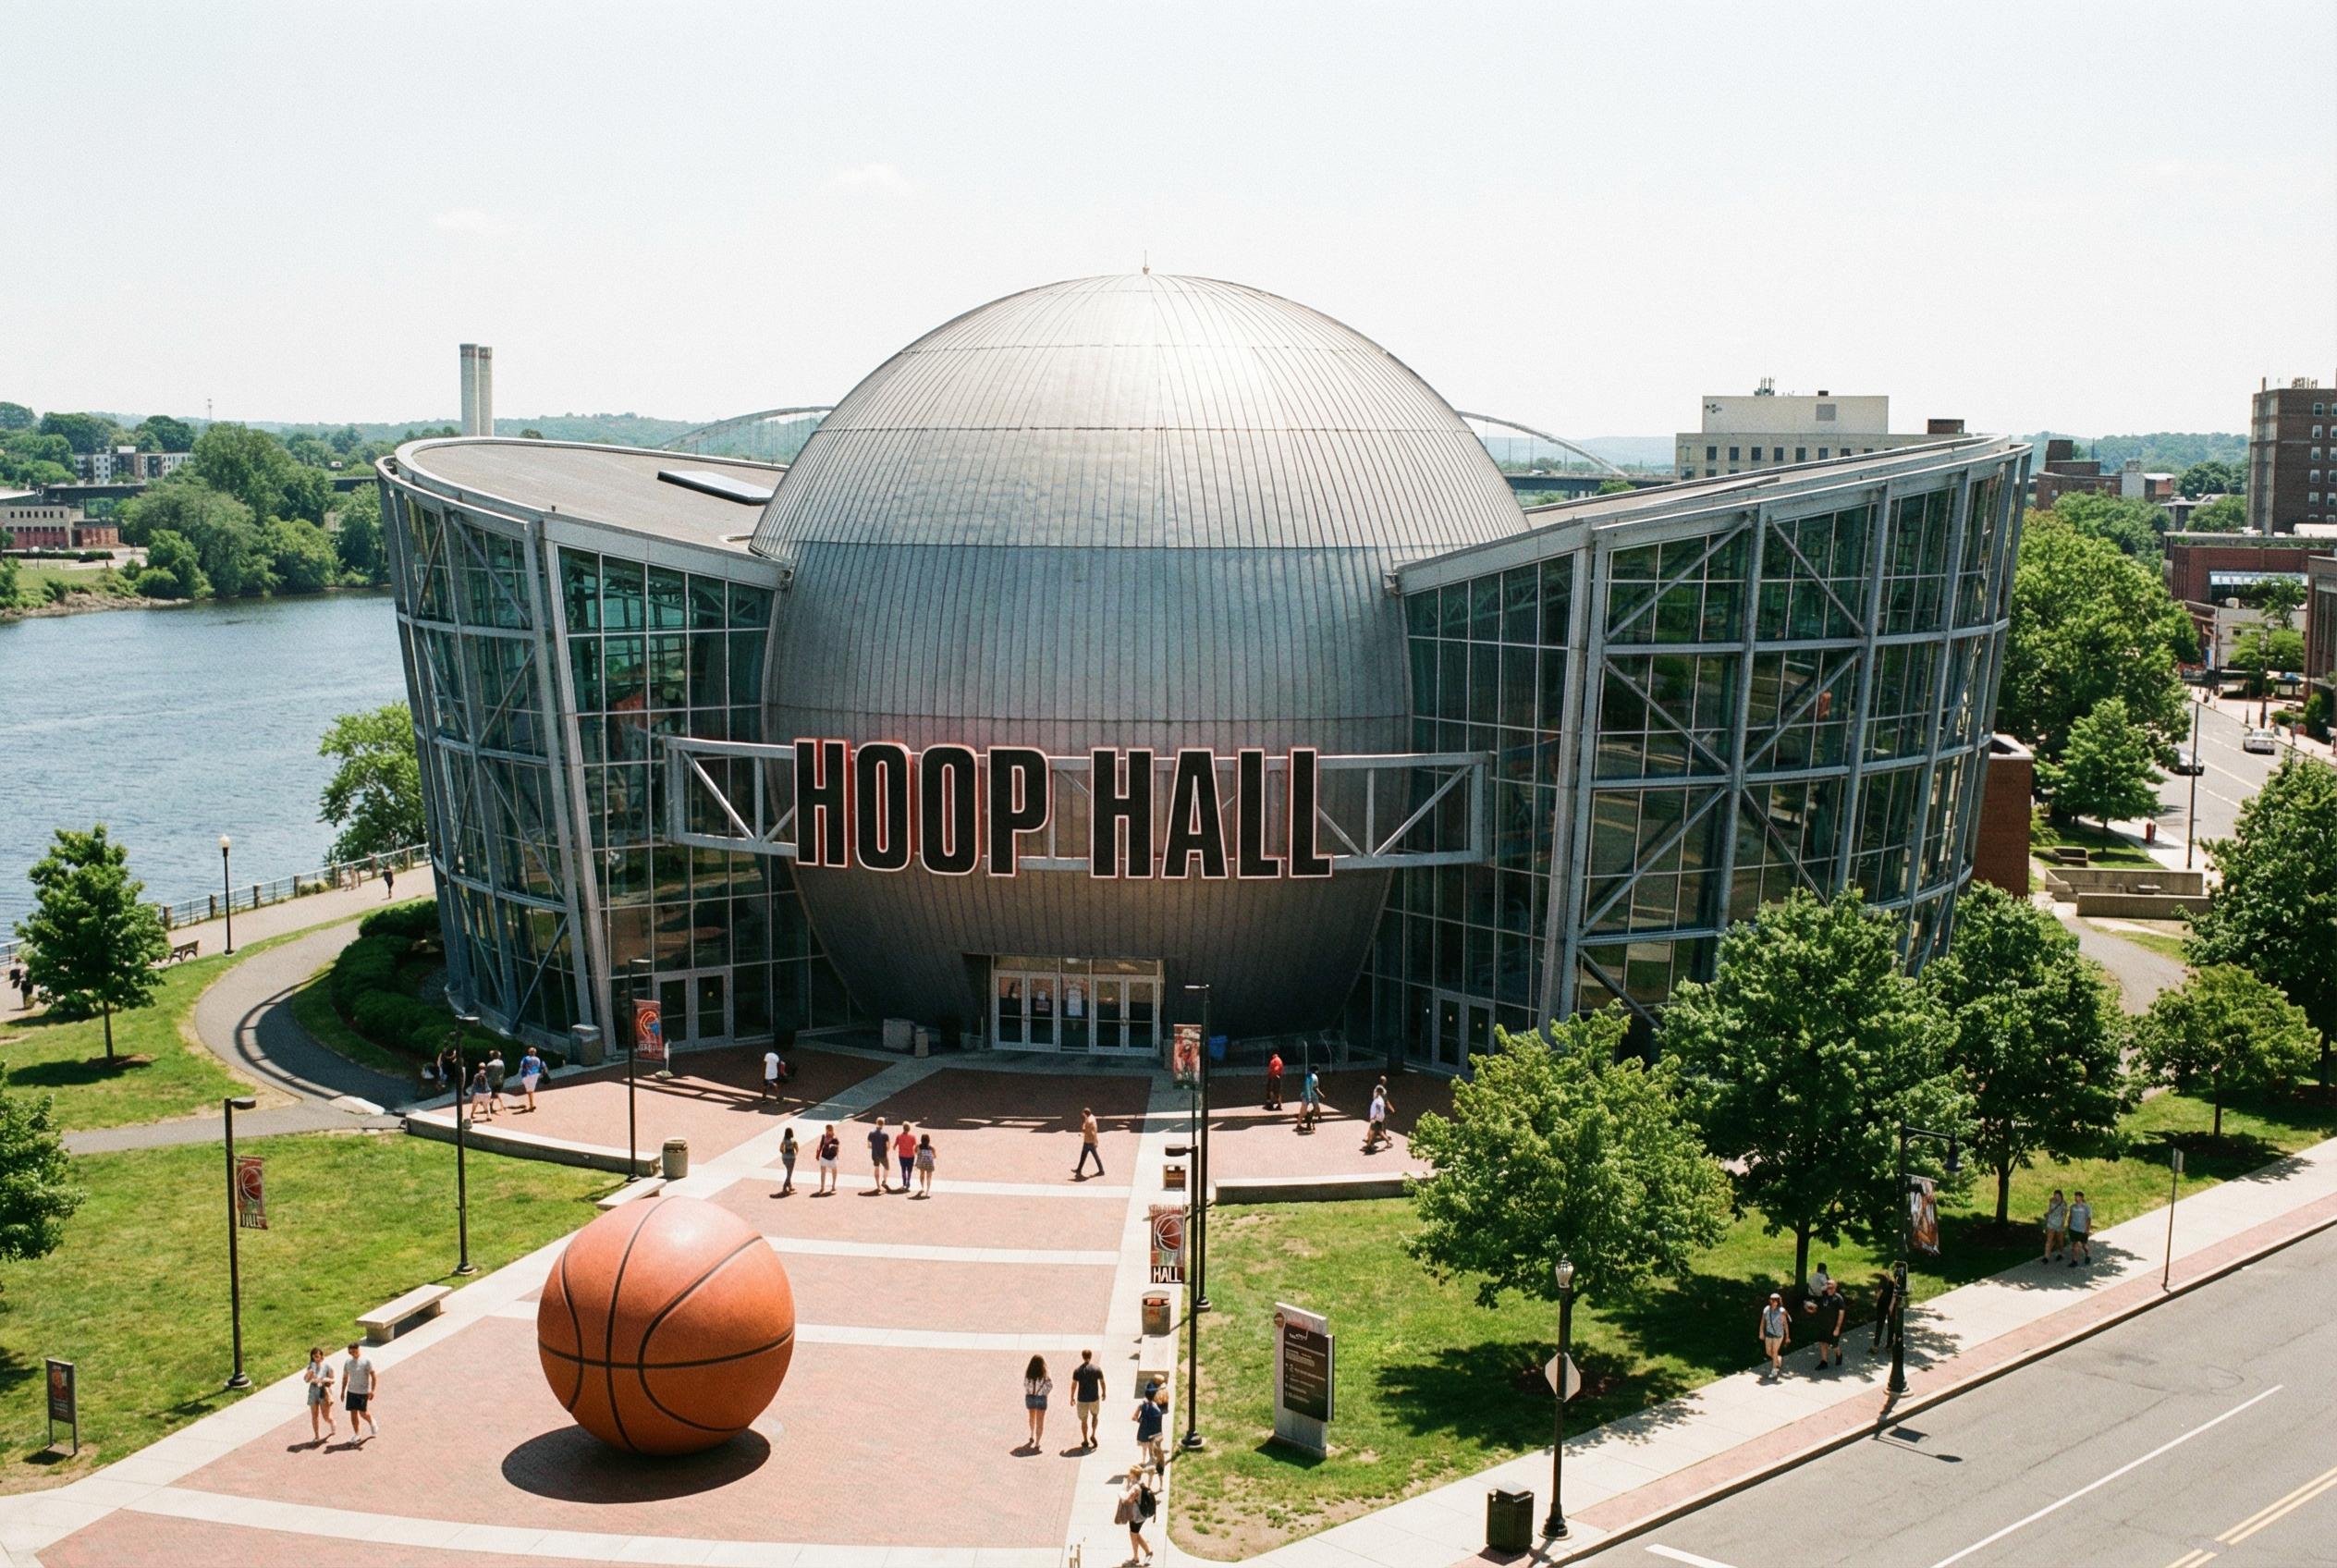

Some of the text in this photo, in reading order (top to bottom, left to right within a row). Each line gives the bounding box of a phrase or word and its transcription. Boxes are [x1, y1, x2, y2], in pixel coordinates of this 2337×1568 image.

[794, 739, 1333, 878] HOOP HALL
[1153, 1267, 1181, 1283] HALL
